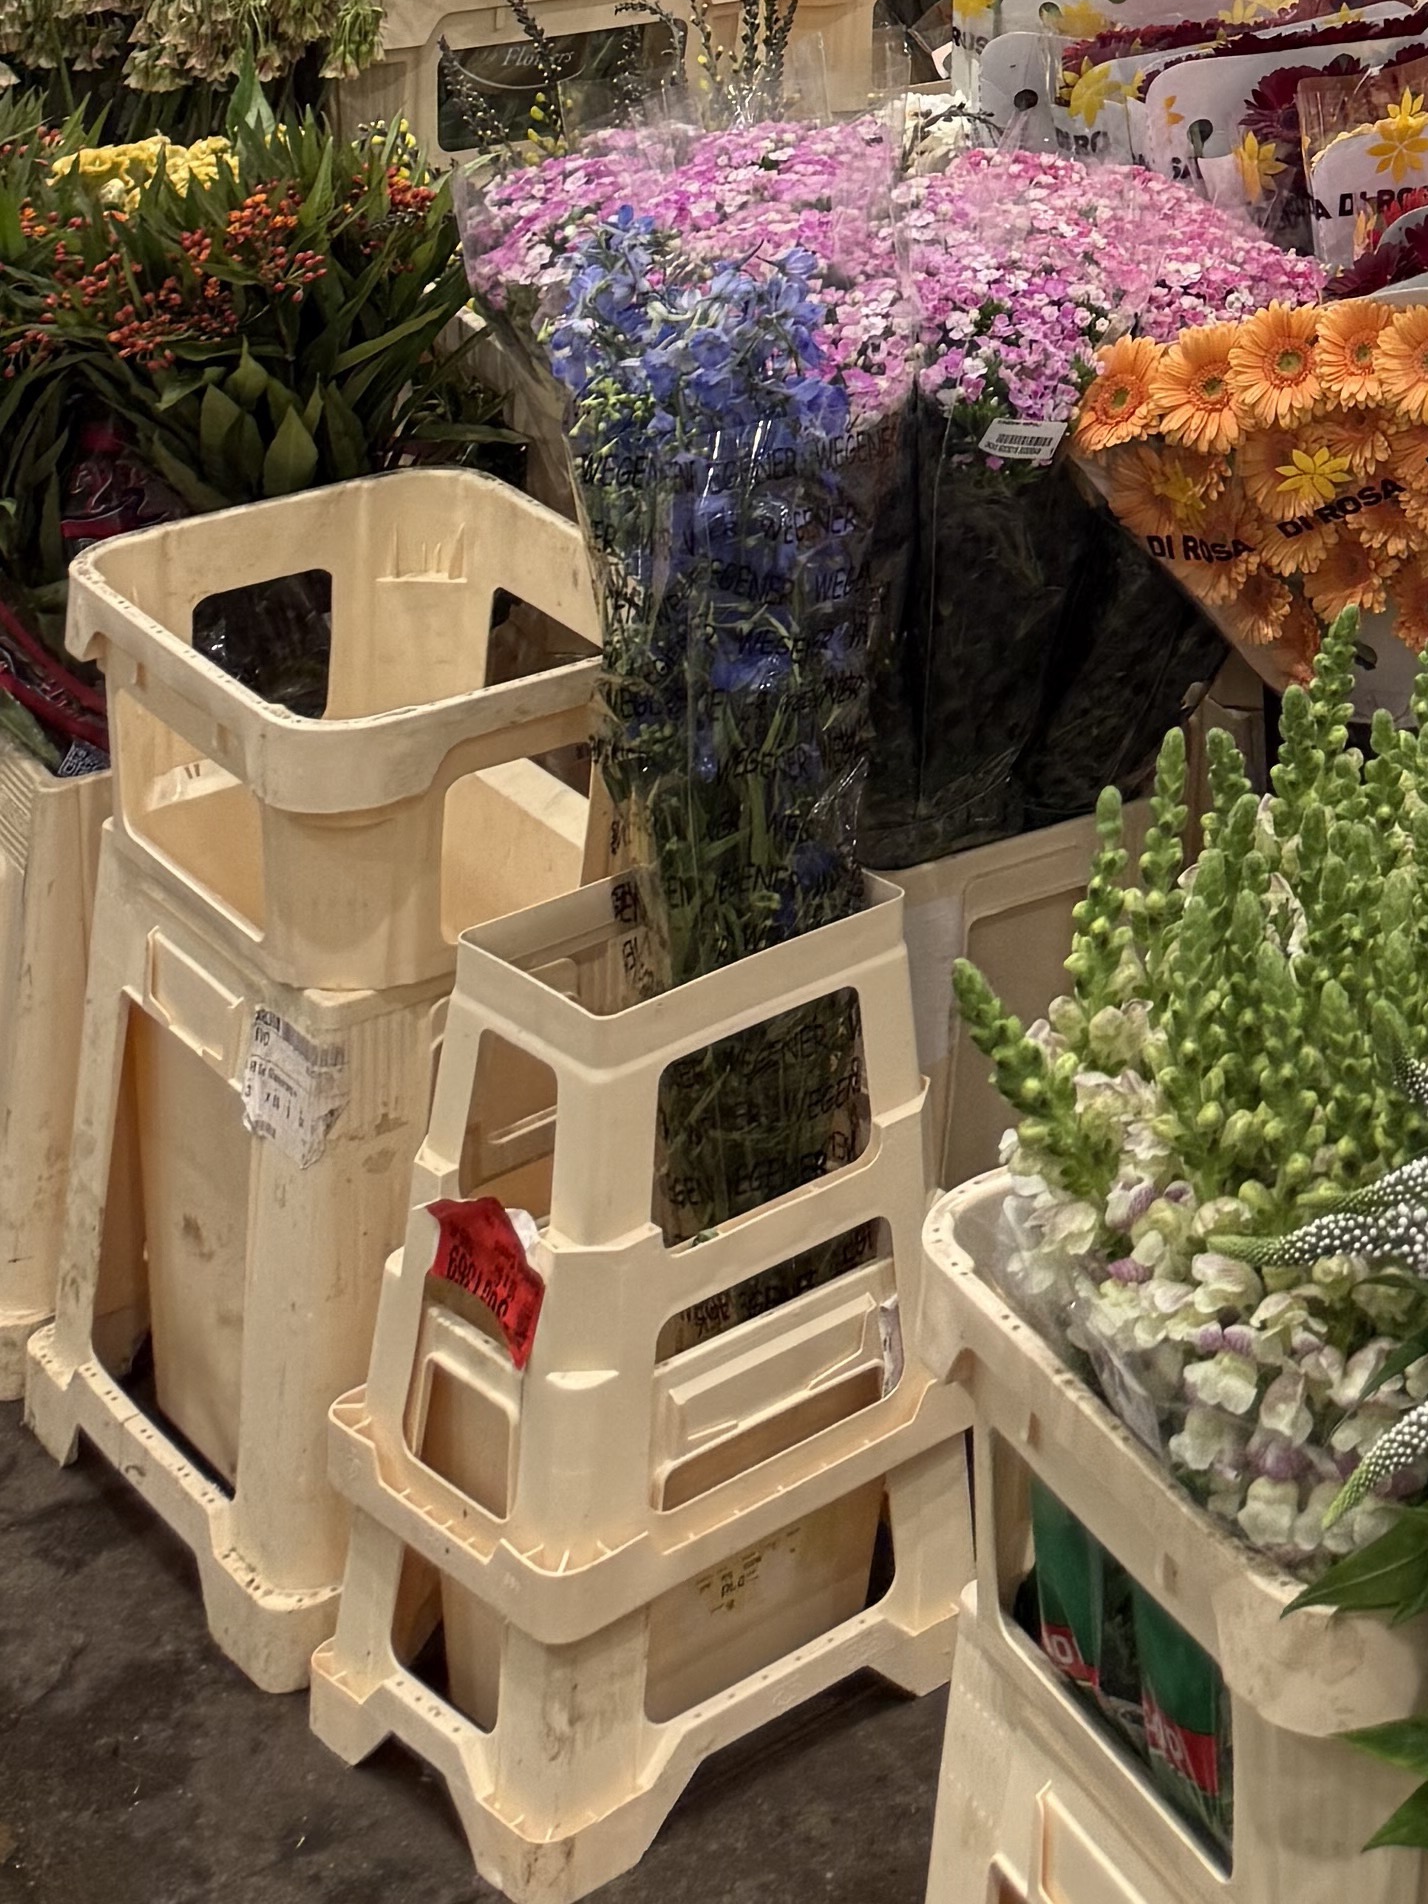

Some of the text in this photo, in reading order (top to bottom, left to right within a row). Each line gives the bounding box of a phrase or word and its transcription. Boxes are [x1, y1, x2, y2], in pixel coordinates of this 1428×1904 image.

[1276, 477, 1408, 539] DI ROSA
[1145, 533, 1256, 564] DI ROSA
